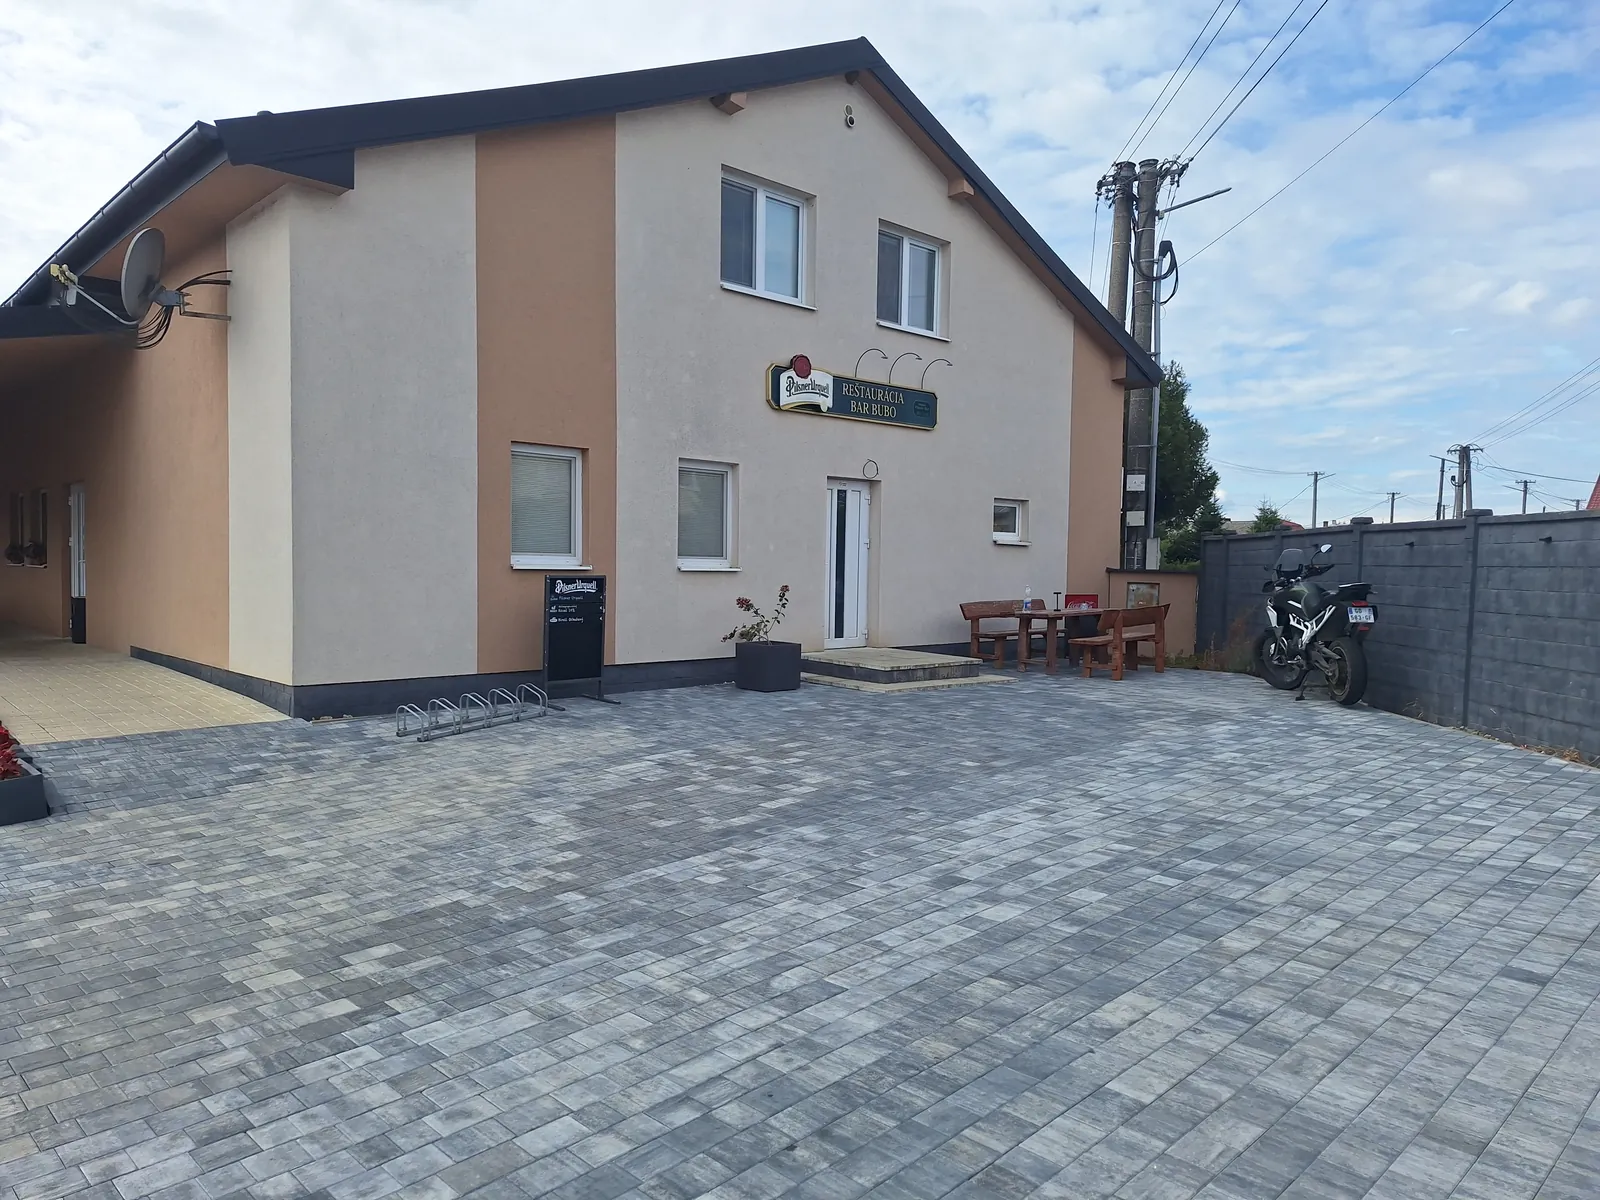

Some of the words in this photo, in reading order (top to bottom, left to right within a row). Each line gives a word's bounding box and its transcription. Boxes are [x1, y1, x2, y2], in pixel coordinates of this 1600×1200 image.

[786, 375, 811, 397] Pilsner
[810, 378, 829, 397] Urquell
[842, 382, 904, 404] REŠTAURÁCIA
[850, 400, 870, 415] BAR
[871, 403, 897, 418] BUBO
[555, 579, 577, 594] Pilsner
[576, 579, 597, 593] Urquell
